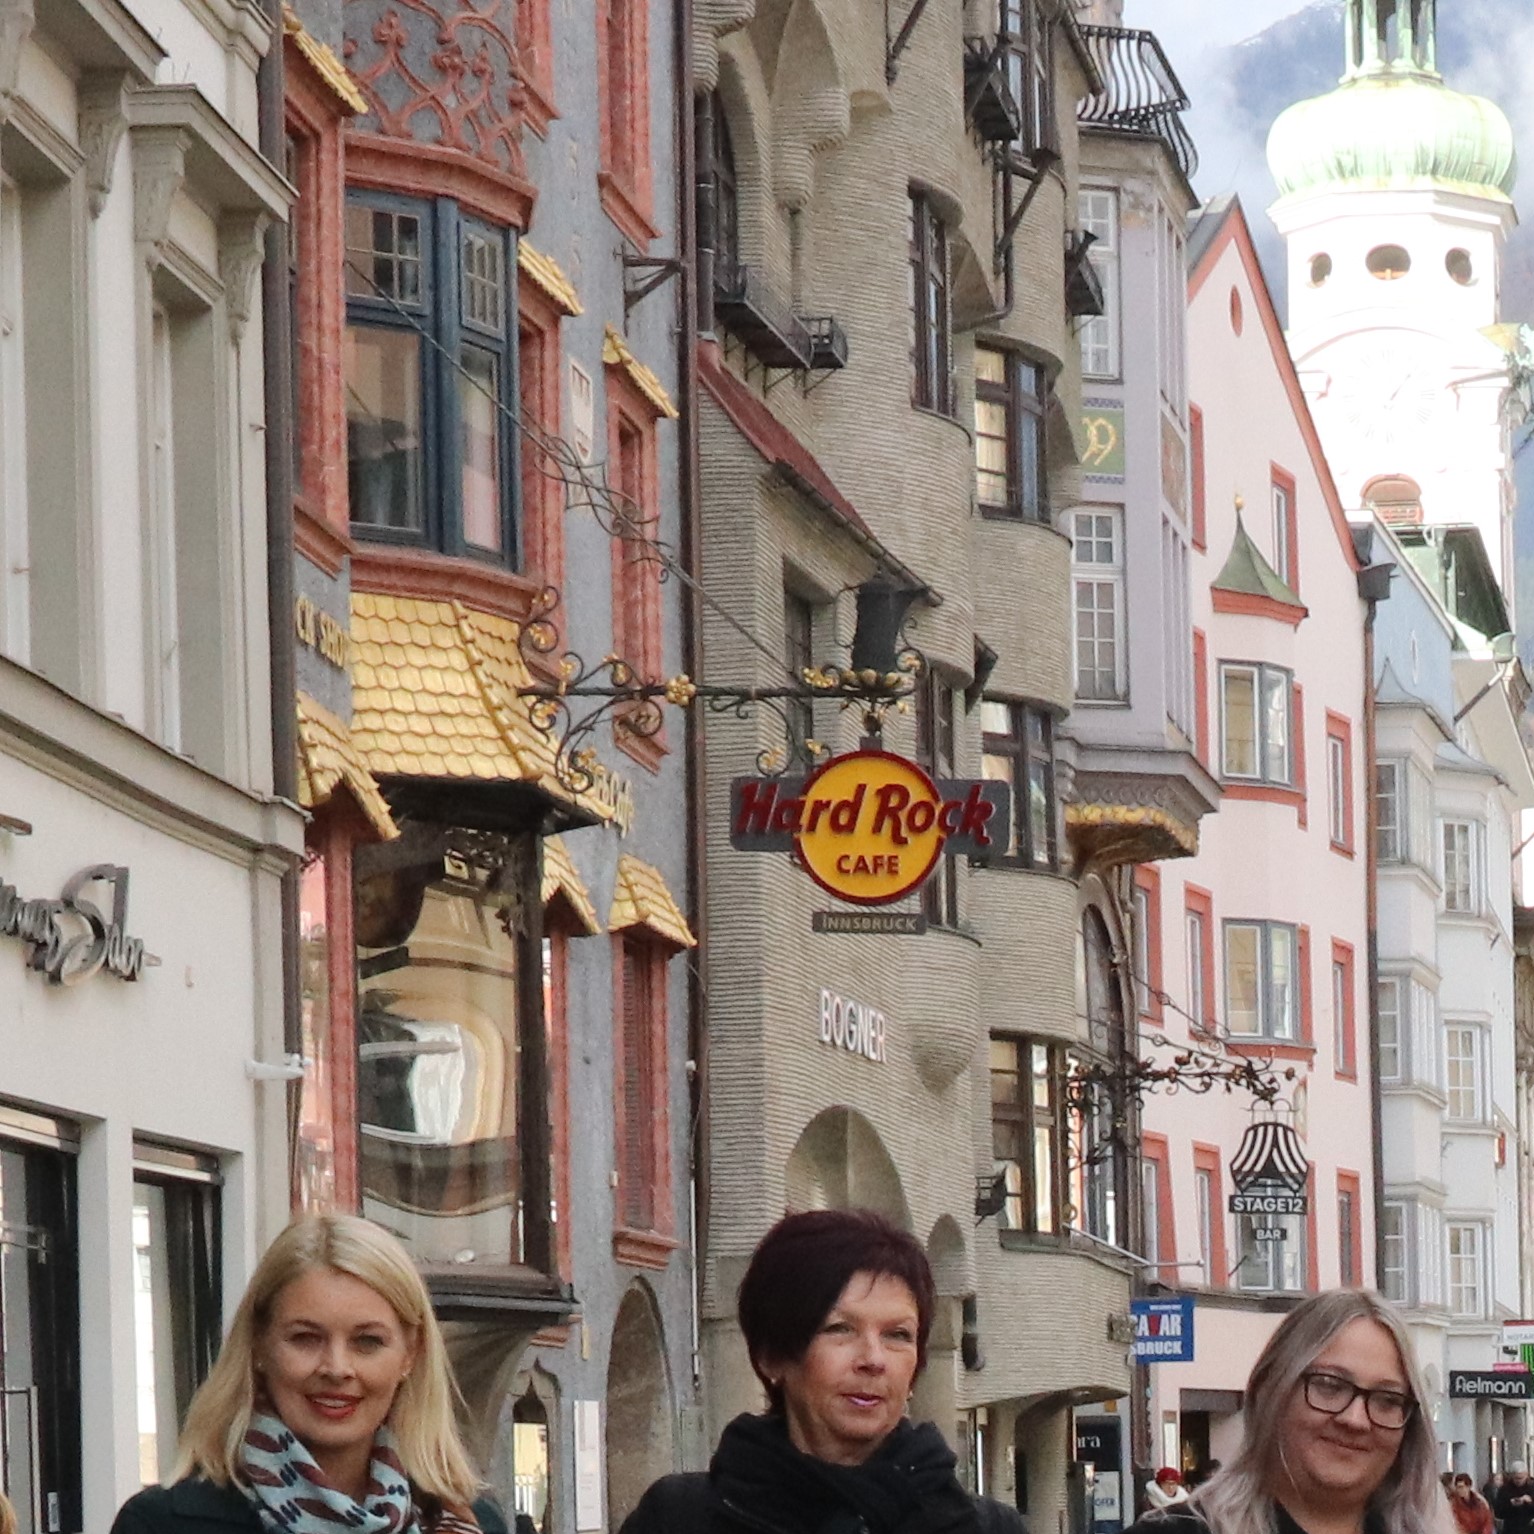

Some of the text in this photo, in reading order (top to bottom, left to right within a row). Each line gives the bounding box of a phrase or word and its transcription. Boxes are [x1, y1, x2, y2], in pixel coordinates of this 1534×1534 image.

[735, 783, 995, 847] Hard Rock
[836, 854, 899, 875] CAFE
[822, 915, 917, 932] INNSBRUCK
[820, 986, 887, 1064] BOGNER
[1233, 1197, 1304, 1213] STAGE12
[1256, 1229, 1282, 1240] BAR
